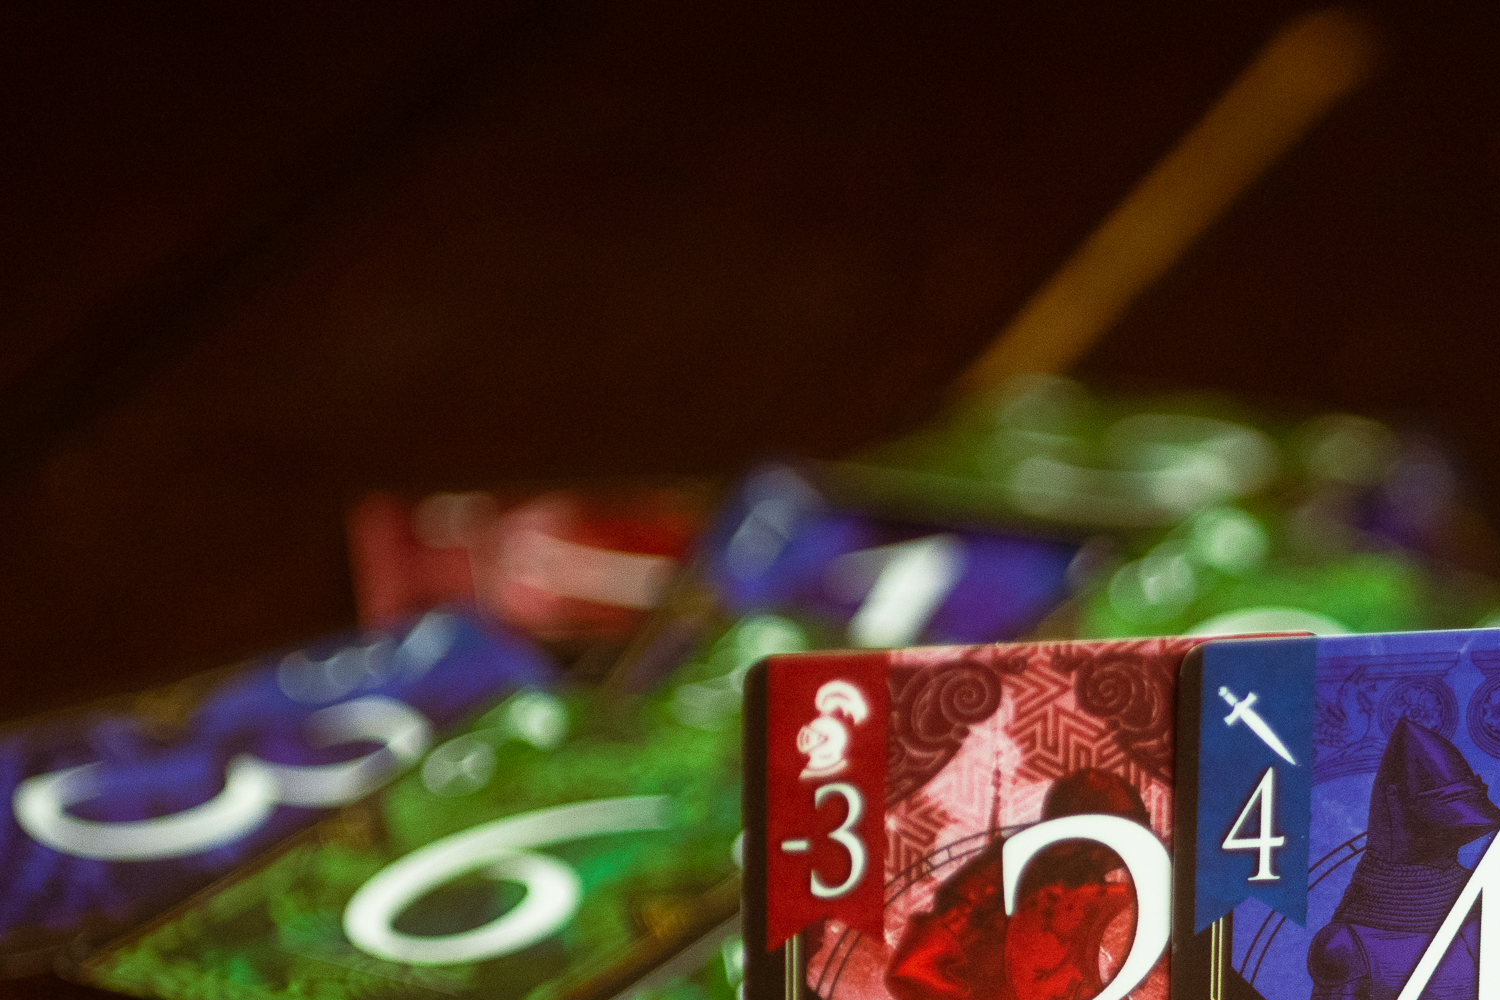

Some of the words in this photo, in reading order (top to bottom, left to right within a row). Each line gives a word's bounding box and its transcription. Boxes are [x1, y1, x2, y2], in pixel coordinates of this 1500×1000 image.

[344, 795, 668, 964] 6
[781, 783, 867, 898] -3
[1221, 767, 1285, 882] 4
